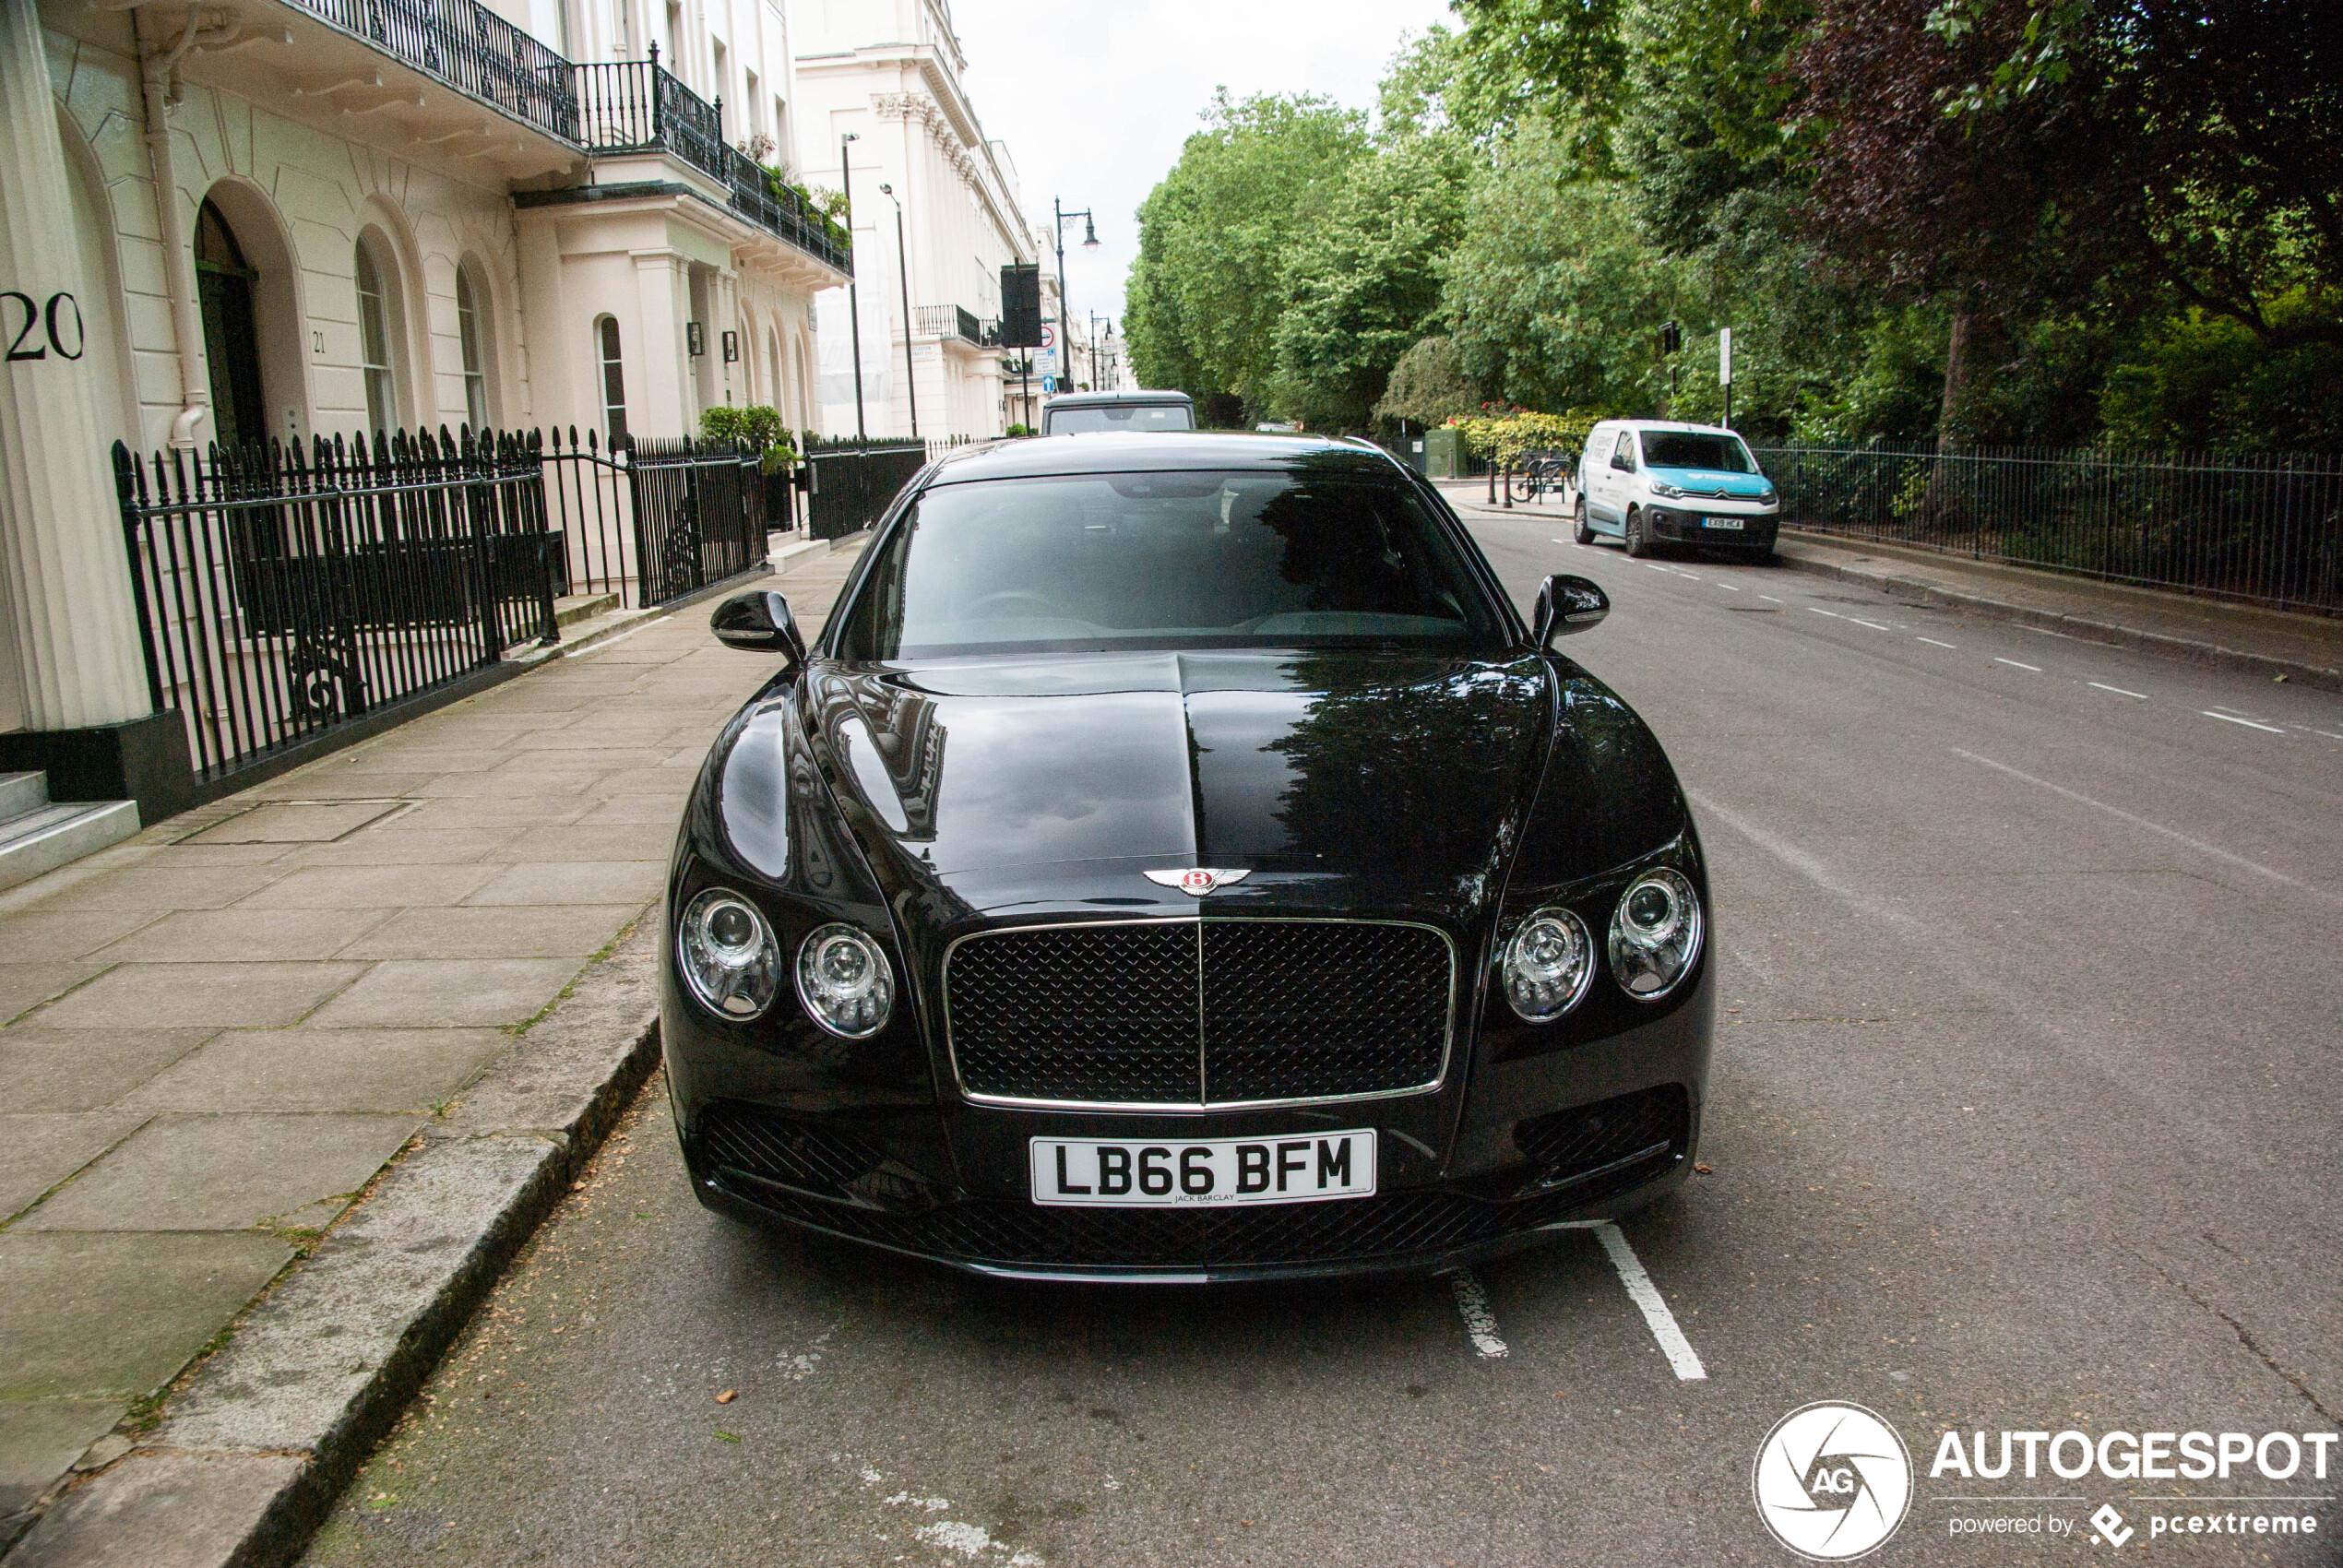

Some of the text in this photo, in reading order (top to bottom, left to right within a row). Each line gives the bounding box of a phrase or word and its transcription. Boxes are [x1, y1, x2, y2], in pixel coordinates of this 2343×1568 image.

[0, 291, 84, 362] 20
[312, 330, 327, 354] 21
[1055, 1137, 1351, 1196] LB66 BFM
[1174, 1194, 1195, 1204] JACK
[1197, 1194, 1235, 1202] BARCLAY
